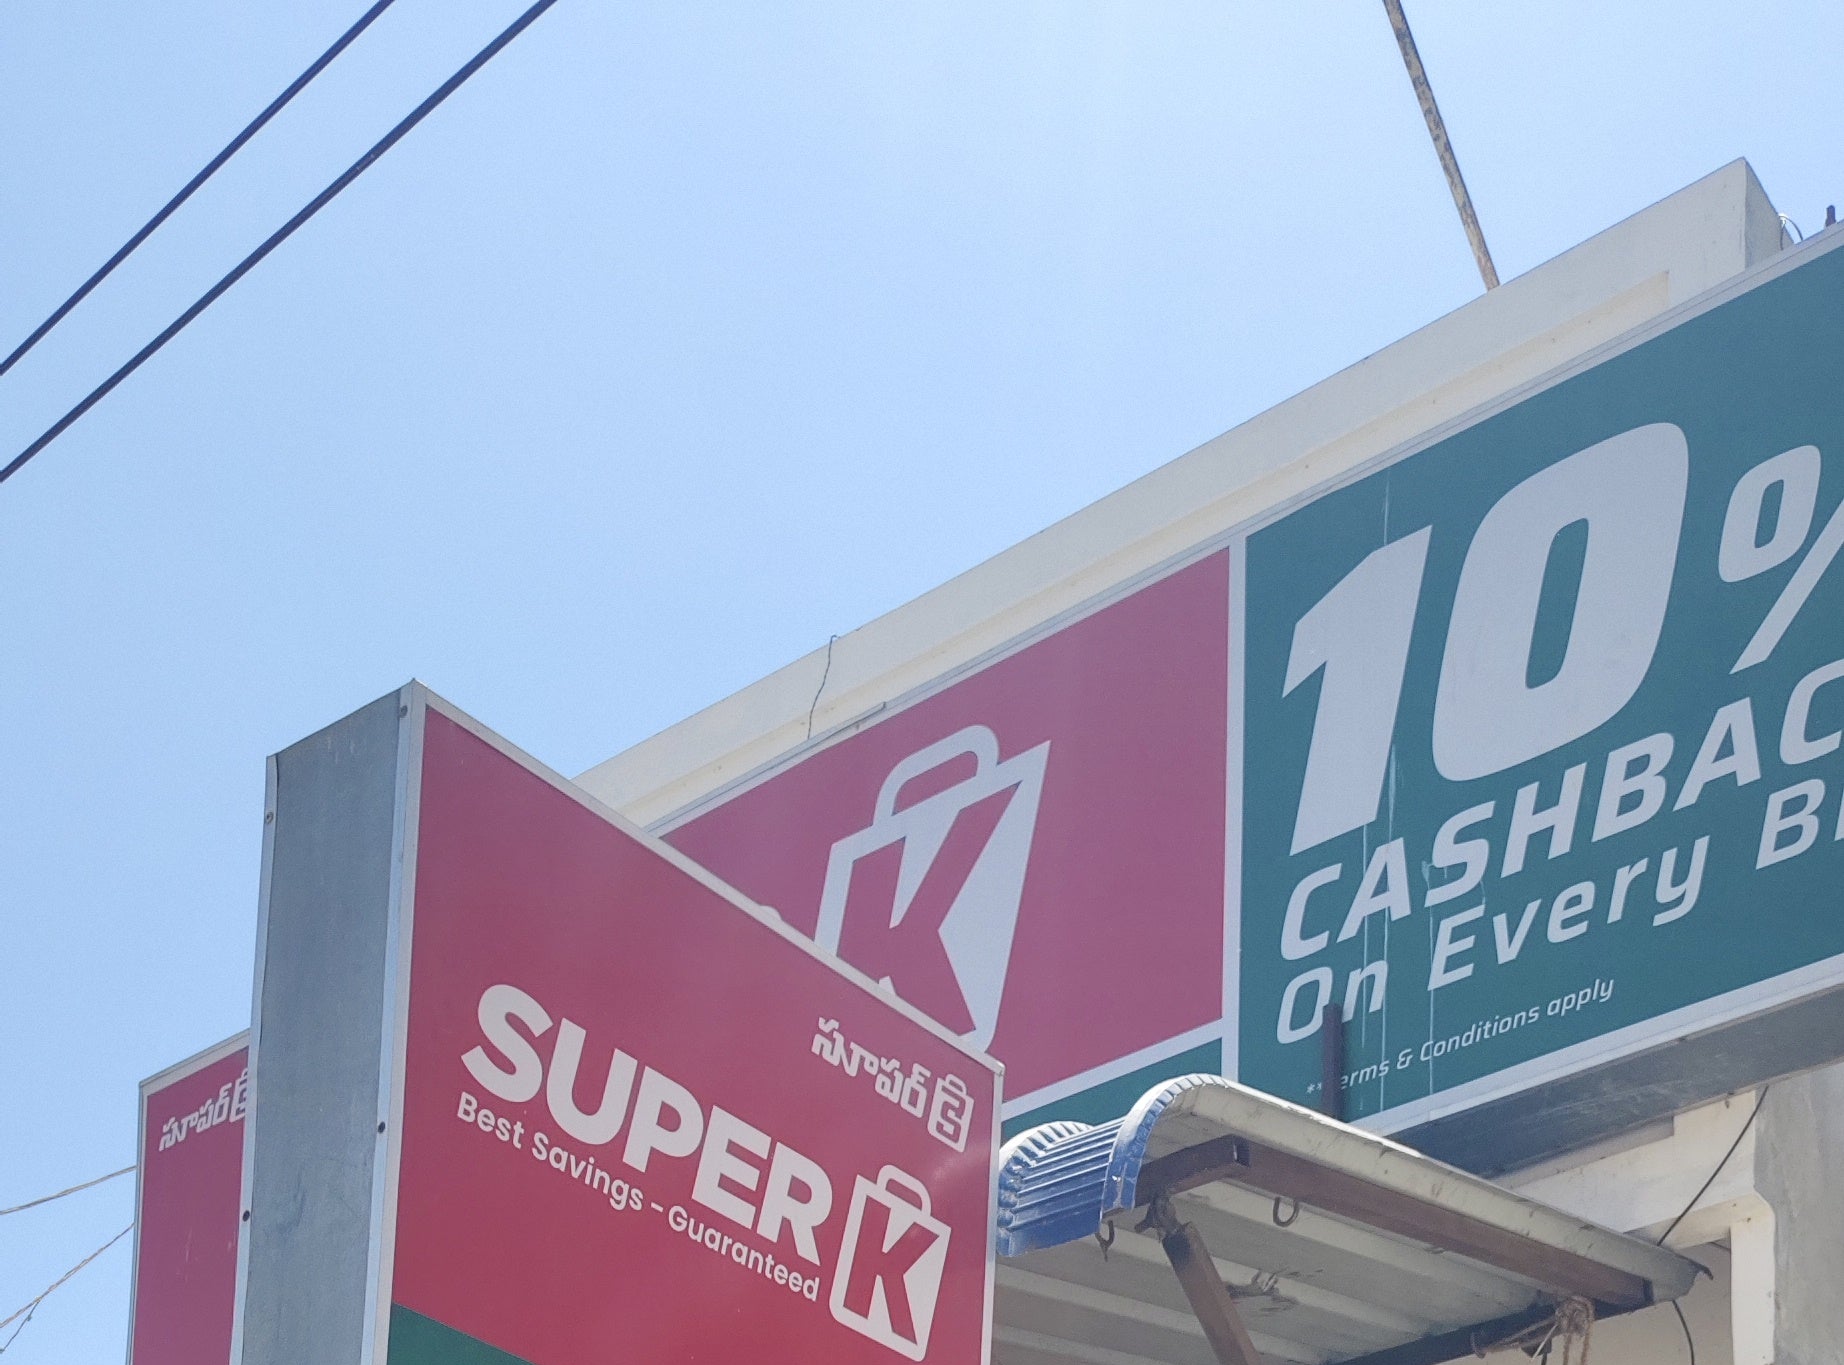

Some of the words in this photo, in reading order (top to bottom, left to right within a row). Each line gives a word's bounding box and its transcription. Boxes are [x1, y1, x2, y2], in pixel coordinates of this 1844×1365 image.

[1281, 660, 1844, 962] CASHBAC
[1427, 835, 1709, 991] Every
[1756, 778, 1844, 871] B
[461, 983, 832, 1266] SUPER
[812, 1016, 928, 1122] సూపర్
[1397, 1048, 1413, 1069] &
[1419, 1004, 1540, 1061] Conditions
[1547, 977, 1615, 1018] apply
[456, 1091, 528, 1144] Best
[531, 1130, 646, 1213] Savings
[668, 1205, 820, 1303] Guaranteed
